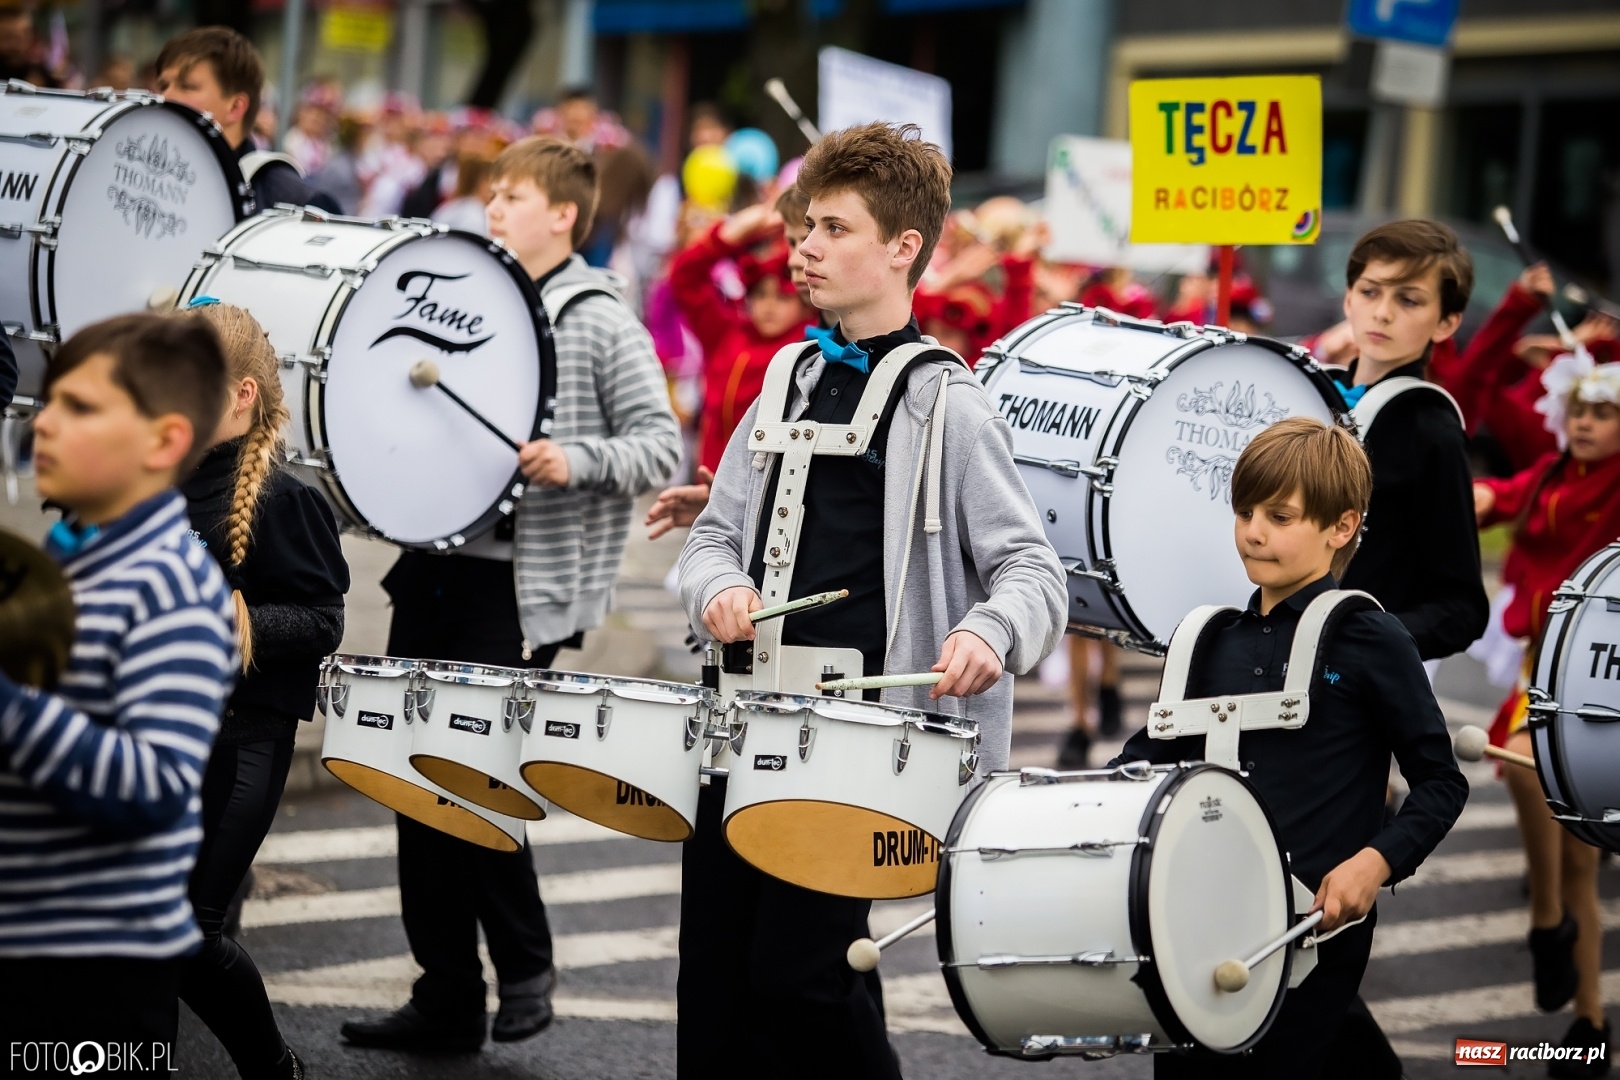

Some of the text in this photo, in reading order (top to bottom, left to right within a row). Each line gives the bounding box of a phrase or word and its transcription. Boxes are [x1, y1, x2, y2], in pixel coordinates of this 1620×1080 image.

[1157, 99, 1289, 167] TĘCZA
[0, 169, 39, 201] NN
[113, 161, 189, 205] THOMANN
[1154, 182, 1290, 213] RACIBÓRZ
[393, 270, 484, 335] Fame
[999, 393, 1102, 440] THOMANN
